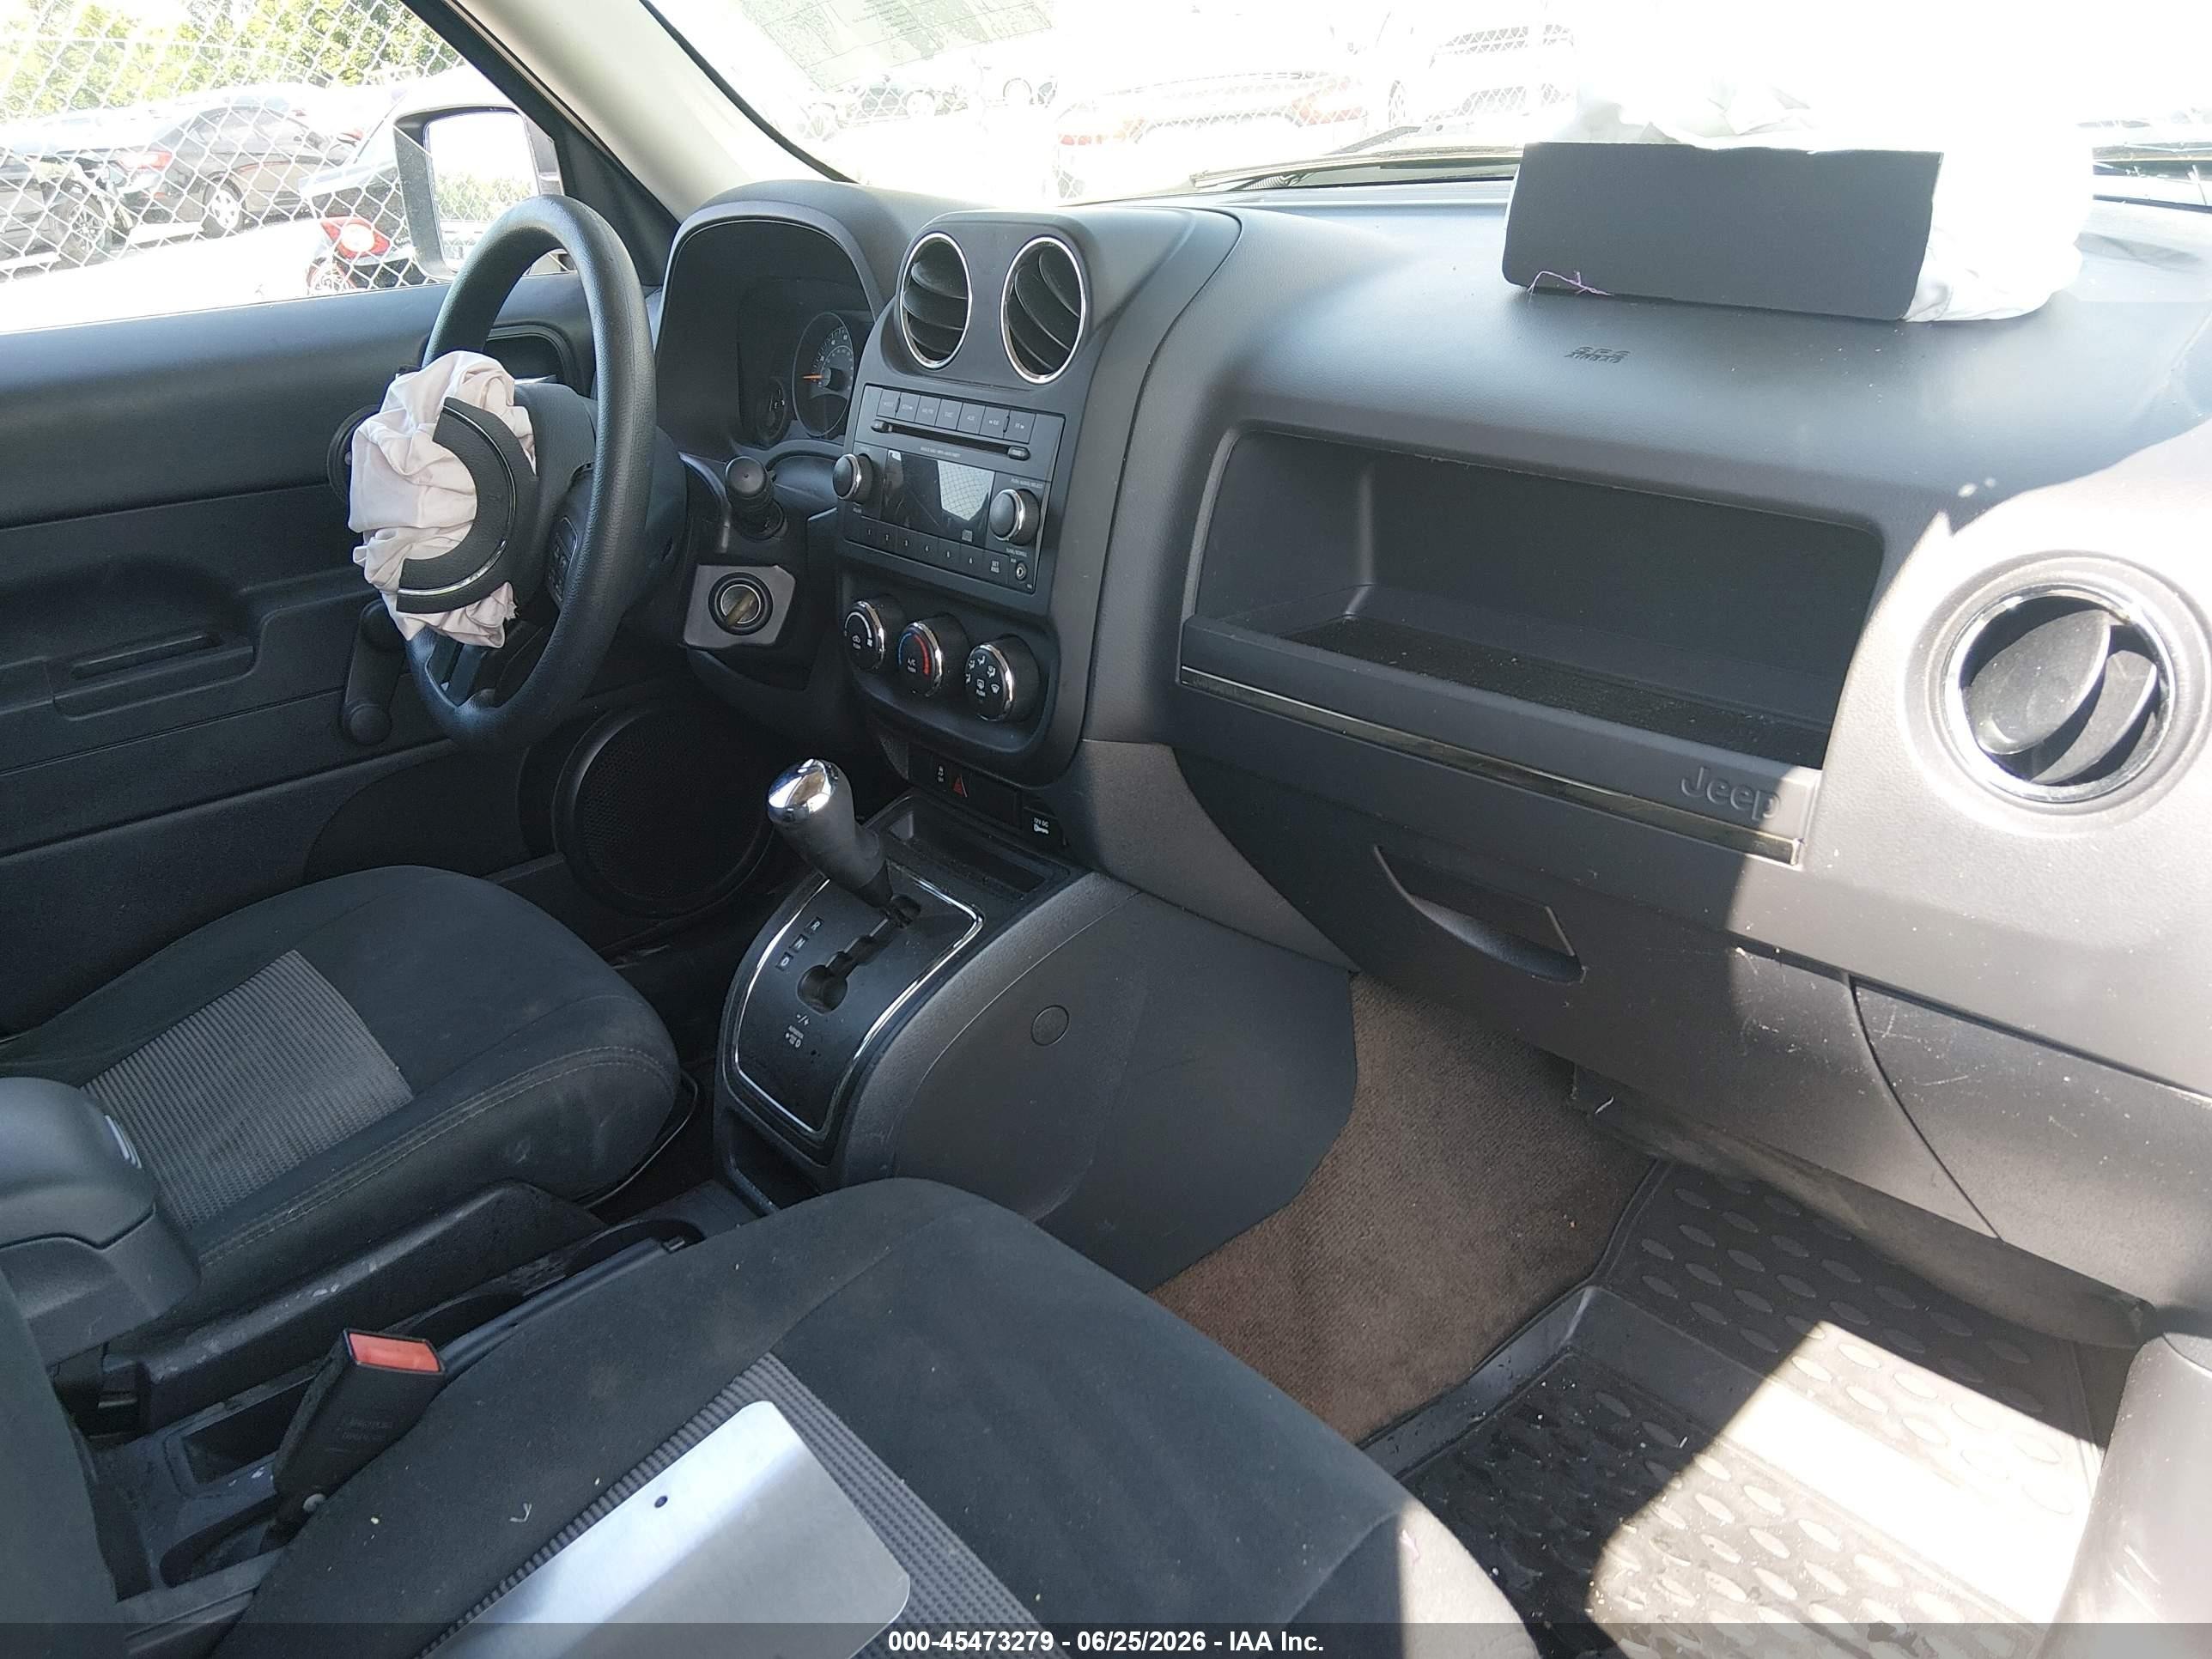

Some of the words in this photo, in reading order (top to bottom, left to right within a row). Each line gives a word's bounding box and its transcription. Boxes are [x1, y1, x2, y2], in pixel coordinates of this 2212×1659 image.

[1680, 766, 1780, 821] Jeep
[811, 921, 821, 931] R
[794, 938, 805, 950] N
[781, 957, 790, 967] D
